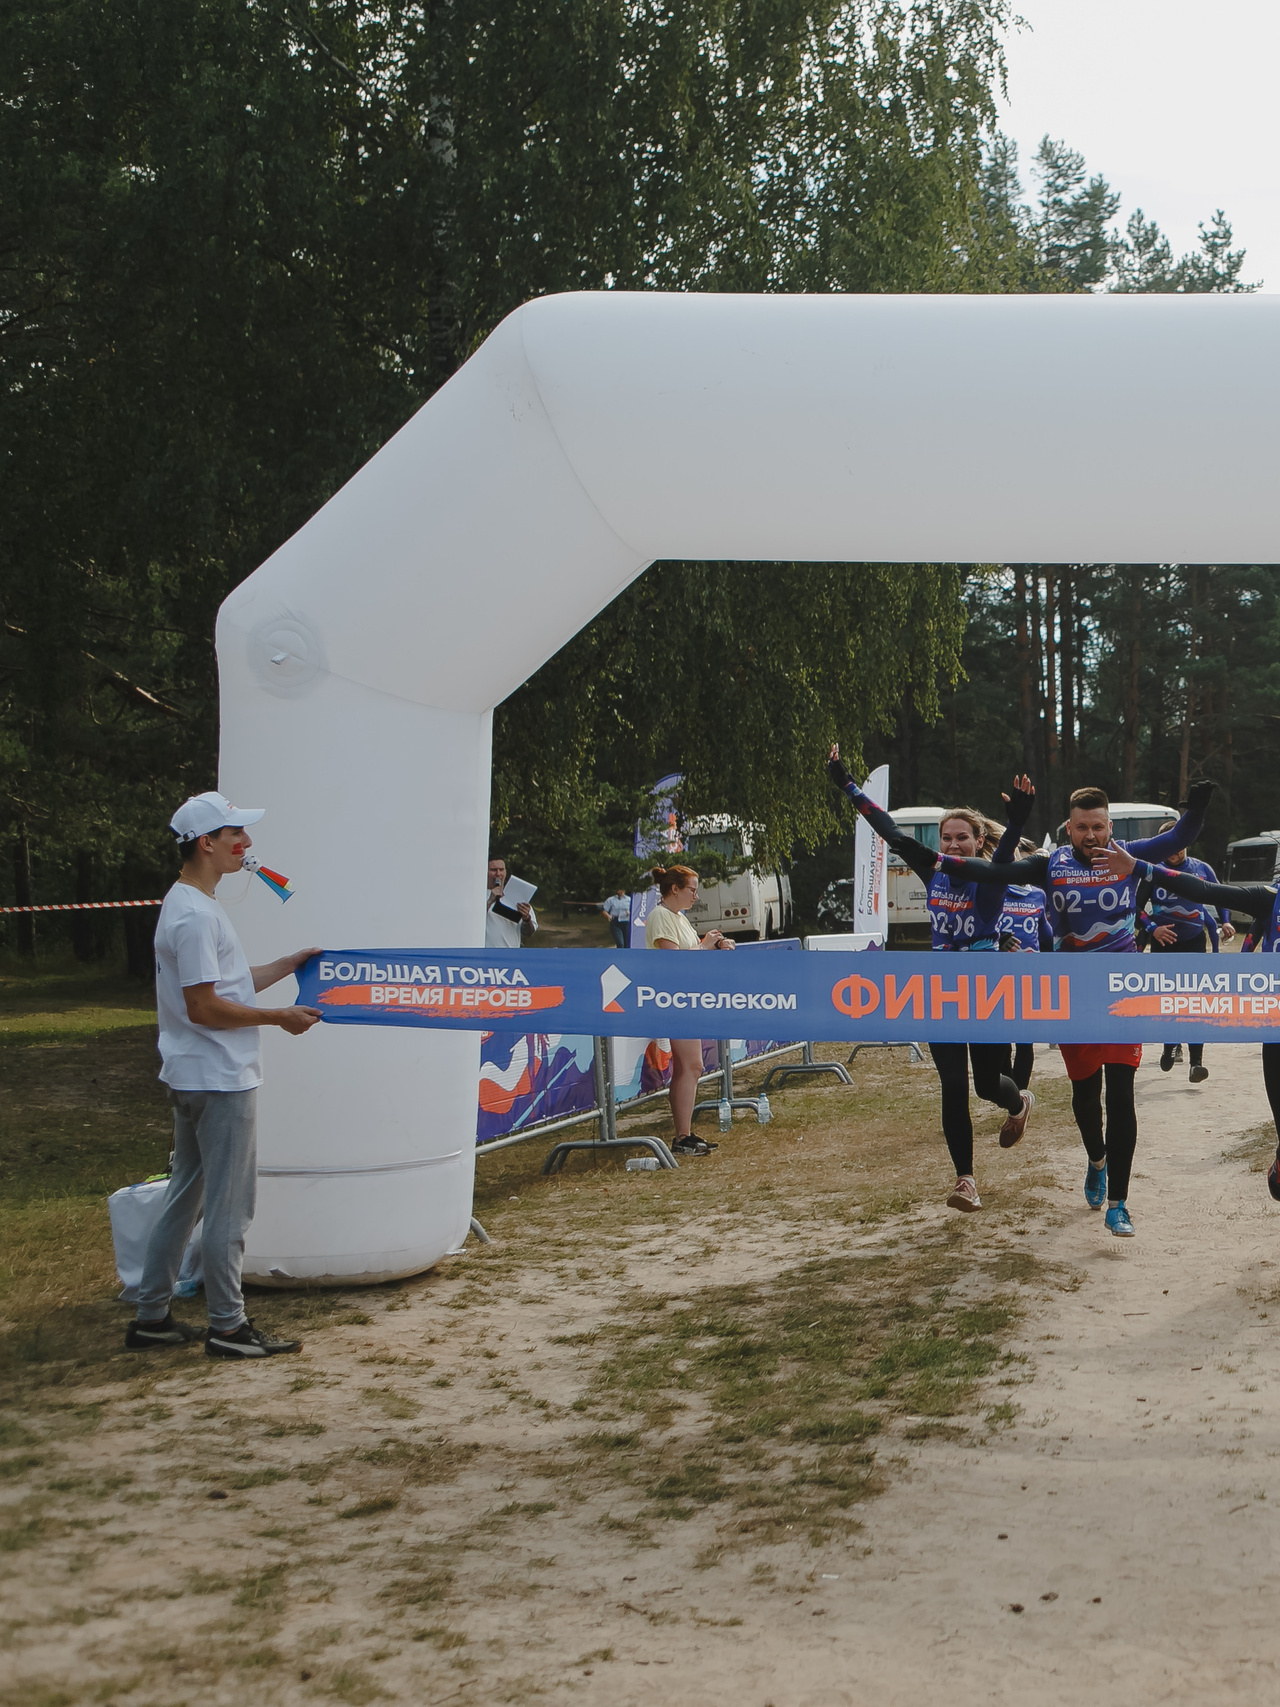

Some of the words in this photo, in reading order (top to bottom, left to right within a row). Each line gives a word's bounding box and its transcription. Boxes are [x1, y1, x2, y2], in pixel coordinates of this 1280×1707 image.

[1051, 869, 1089, 878] БОЛЬШАЯ
[1091, 868, 1111, 877] ГОН
[1066, 876, 1090, 884] ВРЕМЯ
[867, 861, 876, 915] БОЛЬШАЯ
[1052, 886, 1131, 913] 02-04
[318, 961, 442, 984] БОЛЬШАЯ
[446, 966, 530, 986] ГОНКА
[1108, 972, 1230, 992] БОЛЬШАЯ
[370, 986, 444, 1005] ВРЕМЯ
[449, 988, 532, 1007] ГЕРОЕВ
[636, 986, 797, 1010] Ростелеком
[831, 973, 1070, 1020] ФИНИШ
[1160, 996, 1233, 1014] ВРЕМЯ
